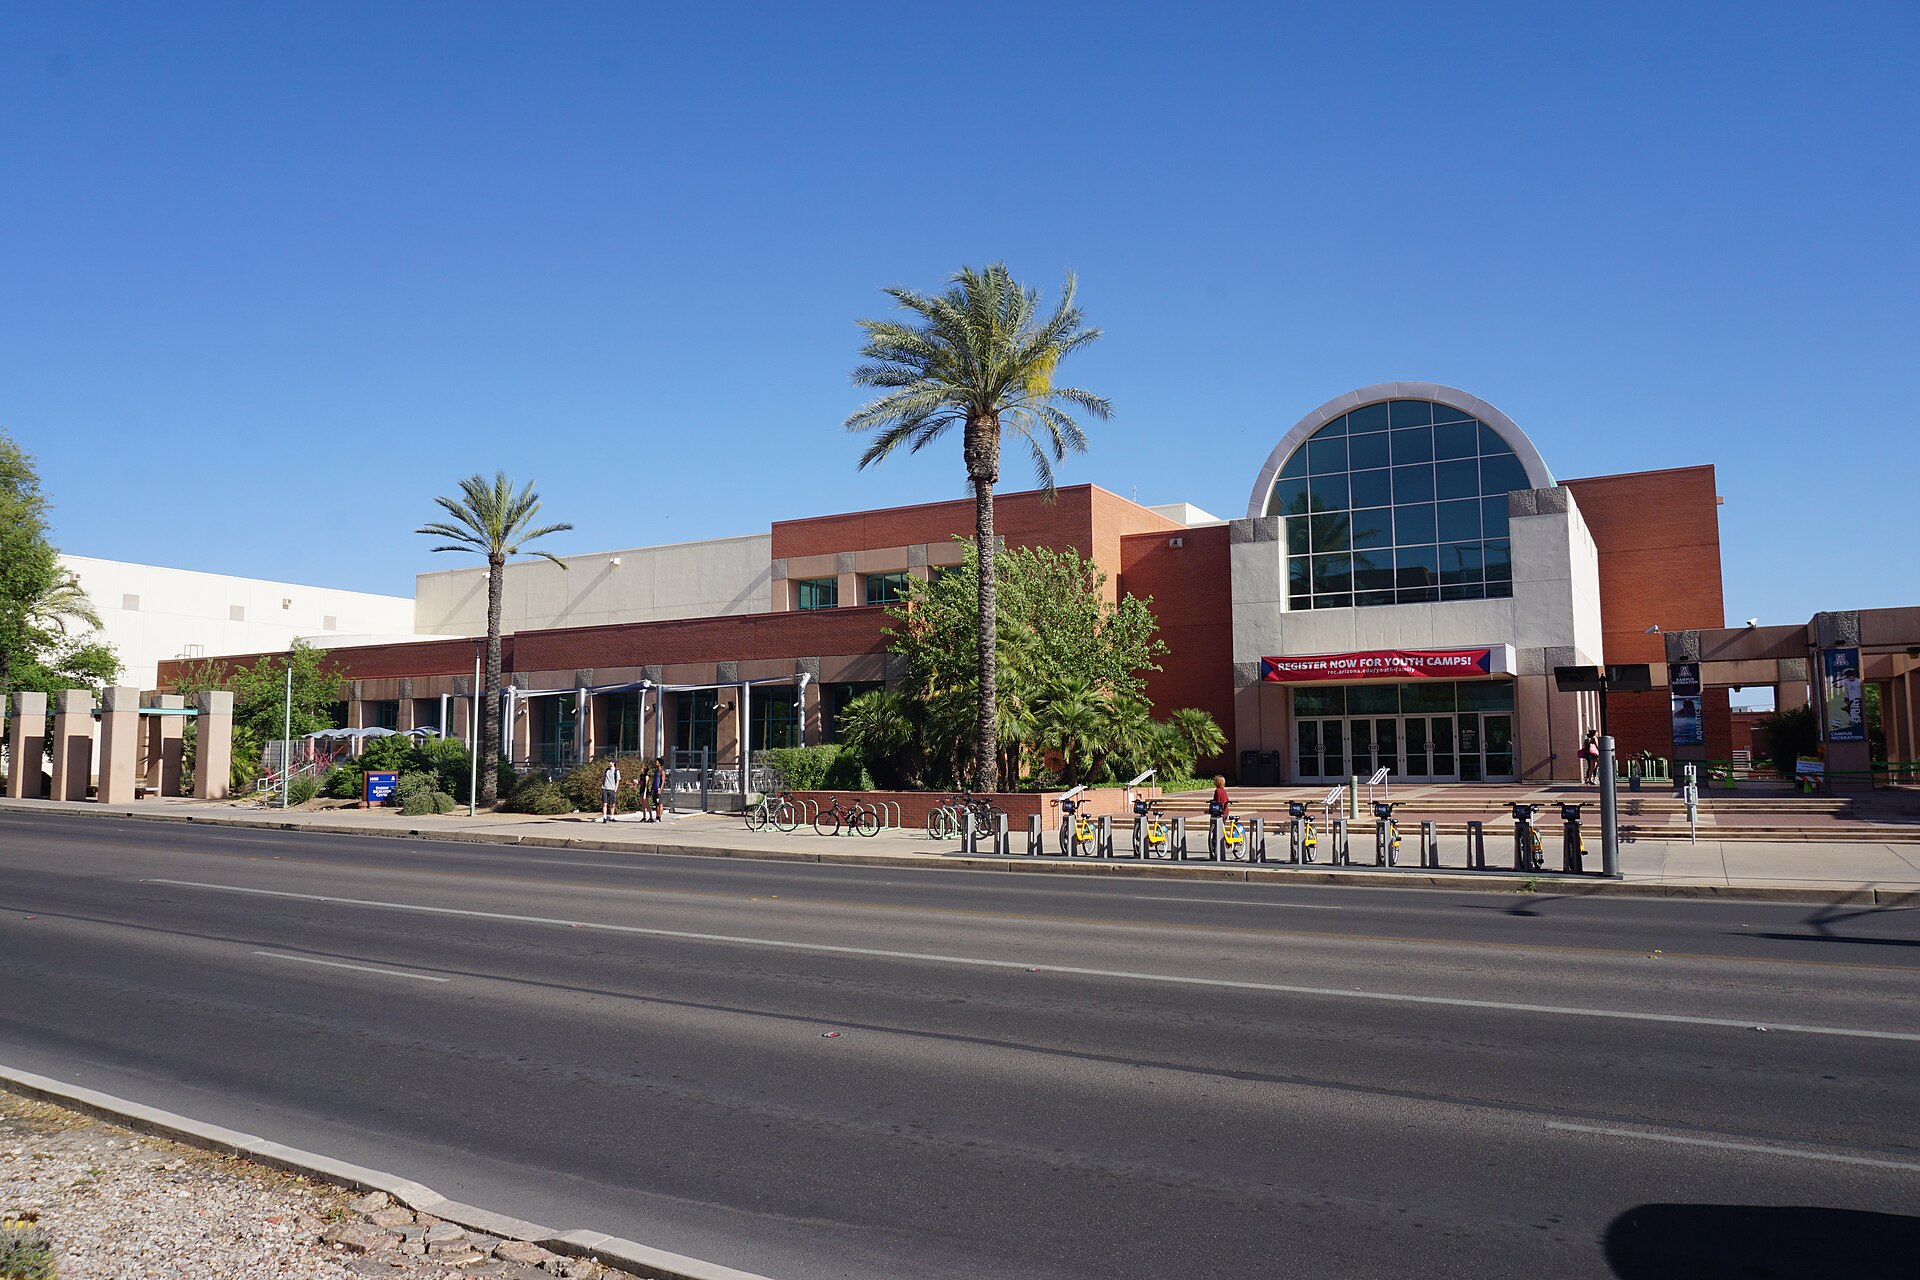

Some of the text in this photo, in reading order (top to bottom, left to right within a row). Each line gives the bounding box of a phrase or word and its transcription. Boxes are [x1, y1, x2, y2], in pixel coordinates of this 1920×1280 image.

[1277, 656, 1472, 671] REGISTER NOW FOR YOUTH CAMPS!
